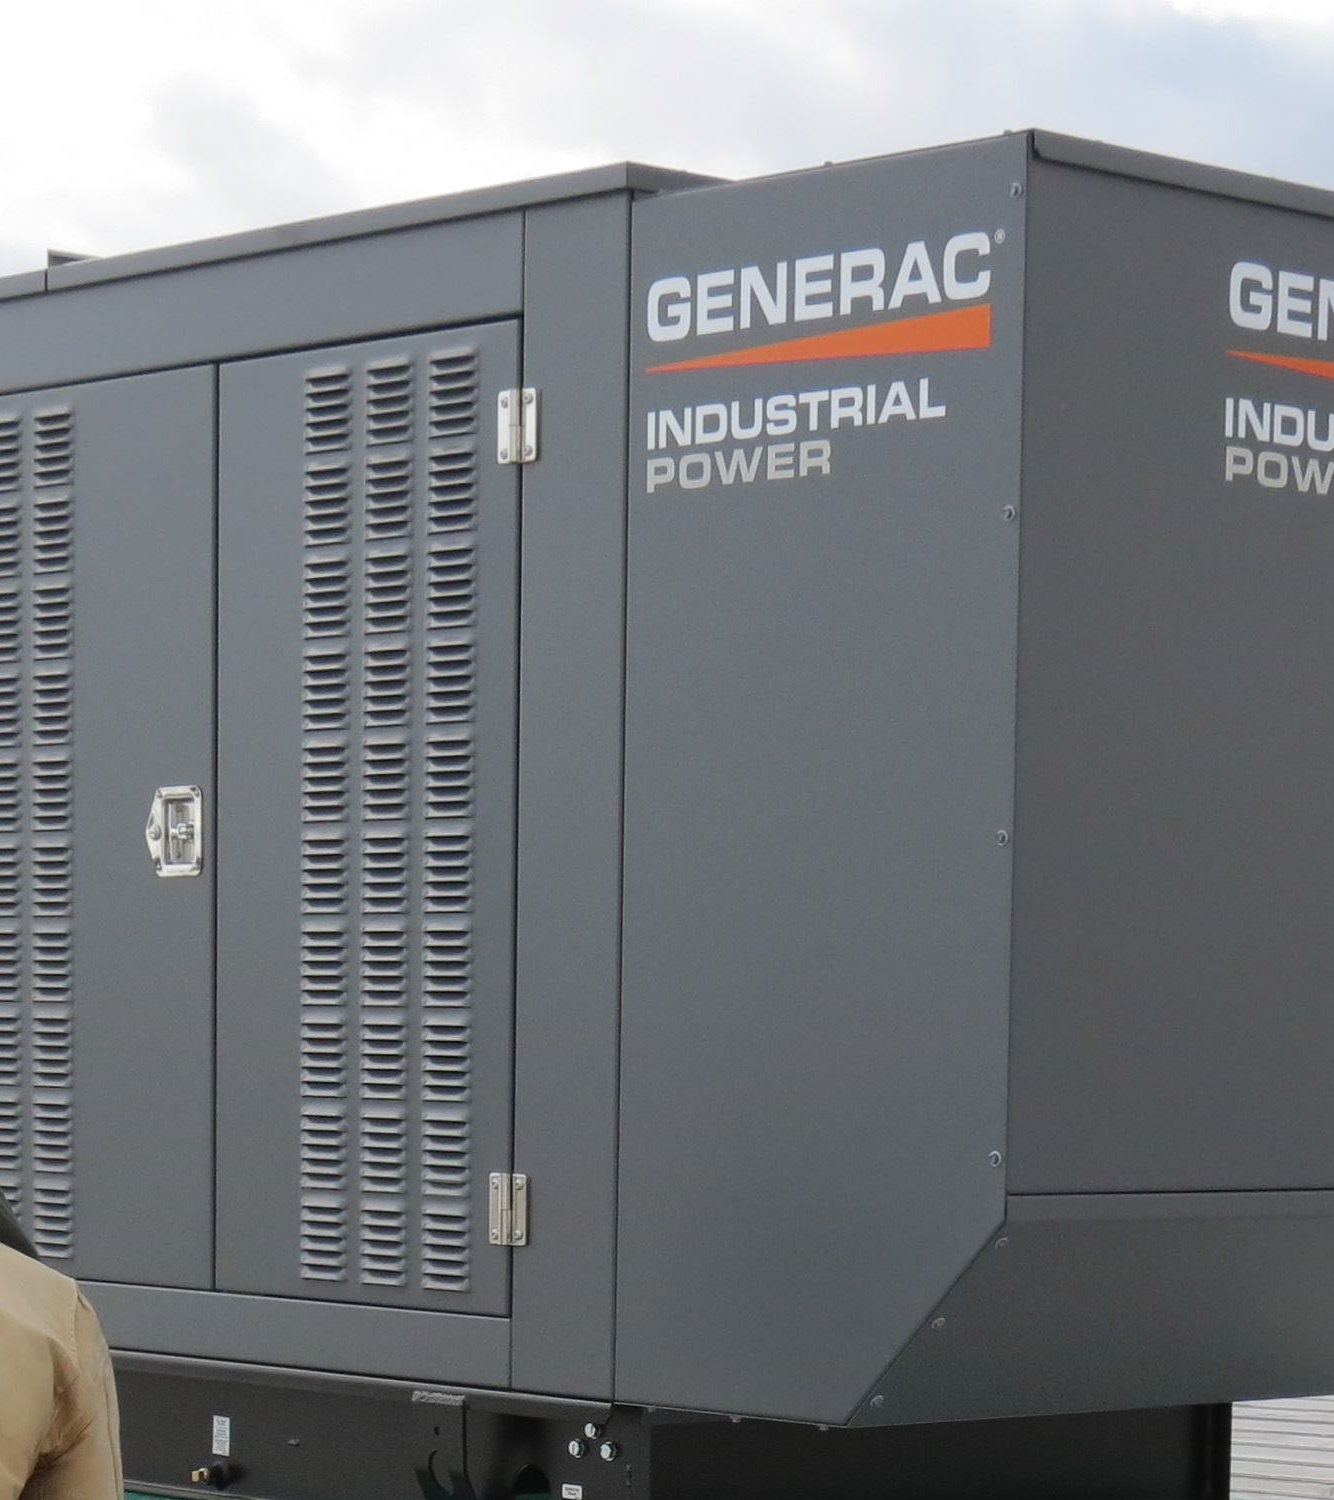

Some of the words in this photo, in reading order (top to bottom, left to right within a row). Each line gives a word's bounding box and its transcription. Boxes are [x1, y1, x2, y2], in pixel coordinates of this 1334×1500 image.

[647, 231, 992, 342] GENERAC
[647, 377, 946, 450] INDUSTRIAL
[647, 439, 831, 493] POWER
